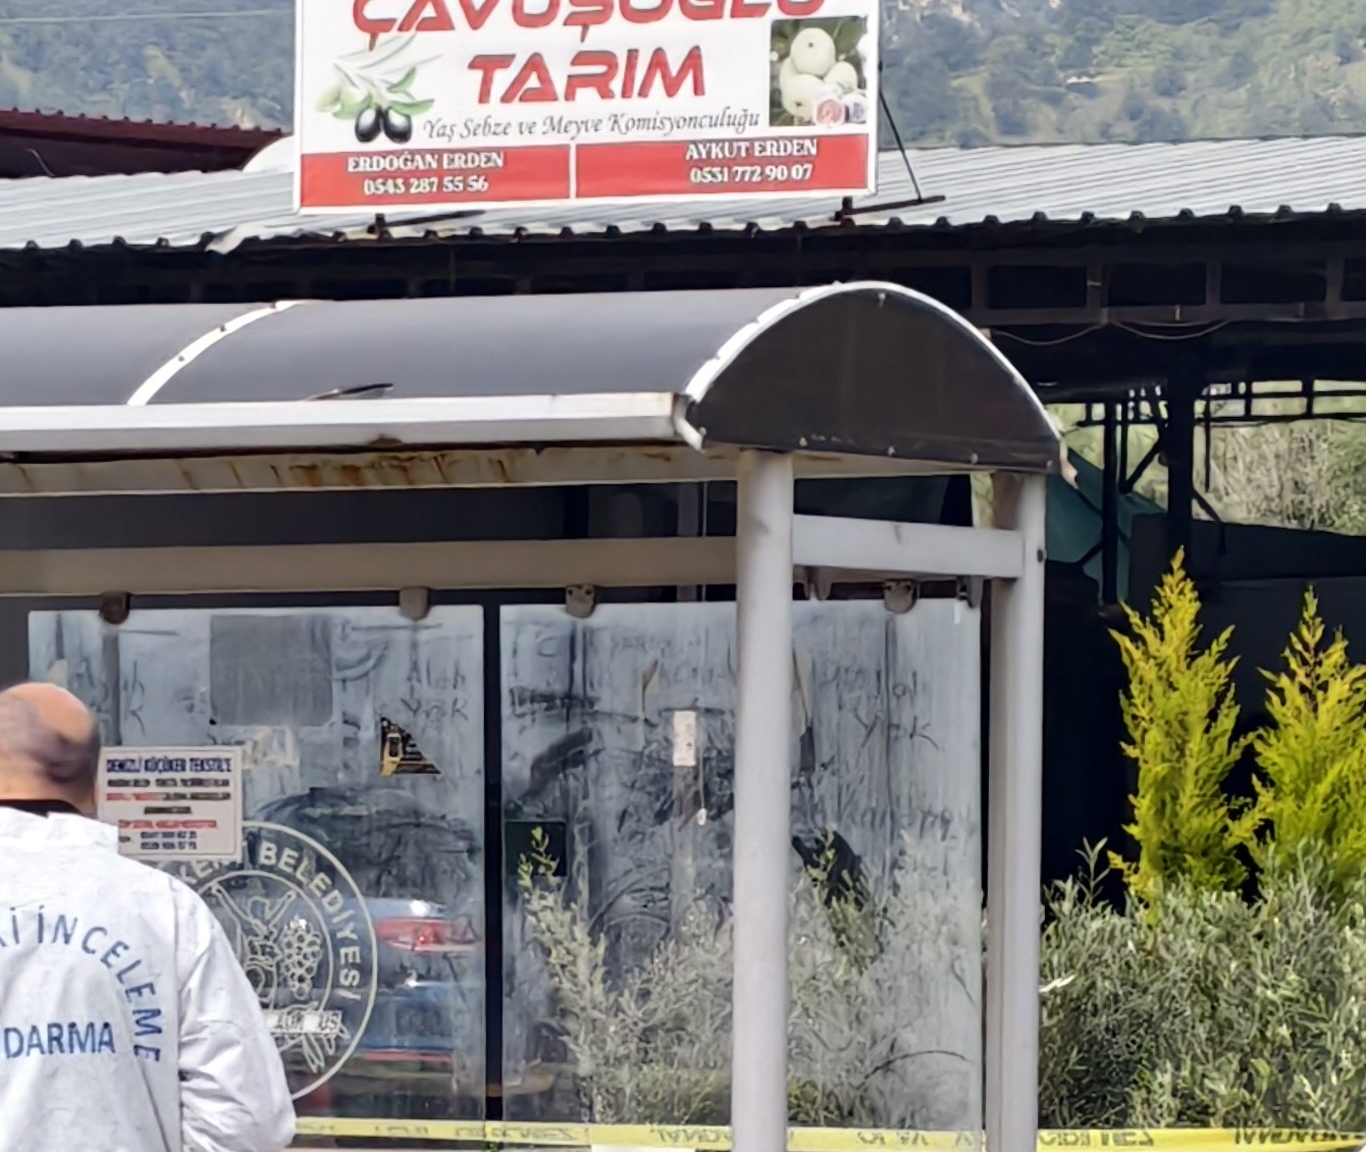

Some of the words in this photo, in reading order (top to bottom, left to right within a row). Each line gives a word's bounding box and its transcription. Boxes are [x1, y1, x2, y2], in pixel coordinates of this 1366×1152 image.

[467, 46, 705, 105] TARIM
[423, 118, 457, 142] Yaş
[462, 115, 514, 139] Sebze
[517, 119, 537, 136] ve
[541, 114, 604, 142] Meyve
[609, 106, 760, 138] Komisyonculuğu
[348, 150, 438, 172] ERDOĞAN
[442, 151, 504, 170] ERDEN
[686, 142, 750, 161] AYKUT
[753, 139, 818, 157] ERDEN
[409, 176, 437, 193] 287
[442, 175, 464, 193] 55
[467, 174, 490, 193] 56
[732, 164, 761, 182] 772
[765, 164, 788, 181] 90
[791, 163, 813, 181] 07
[37, 903, 163, 1063] İNCELEME
